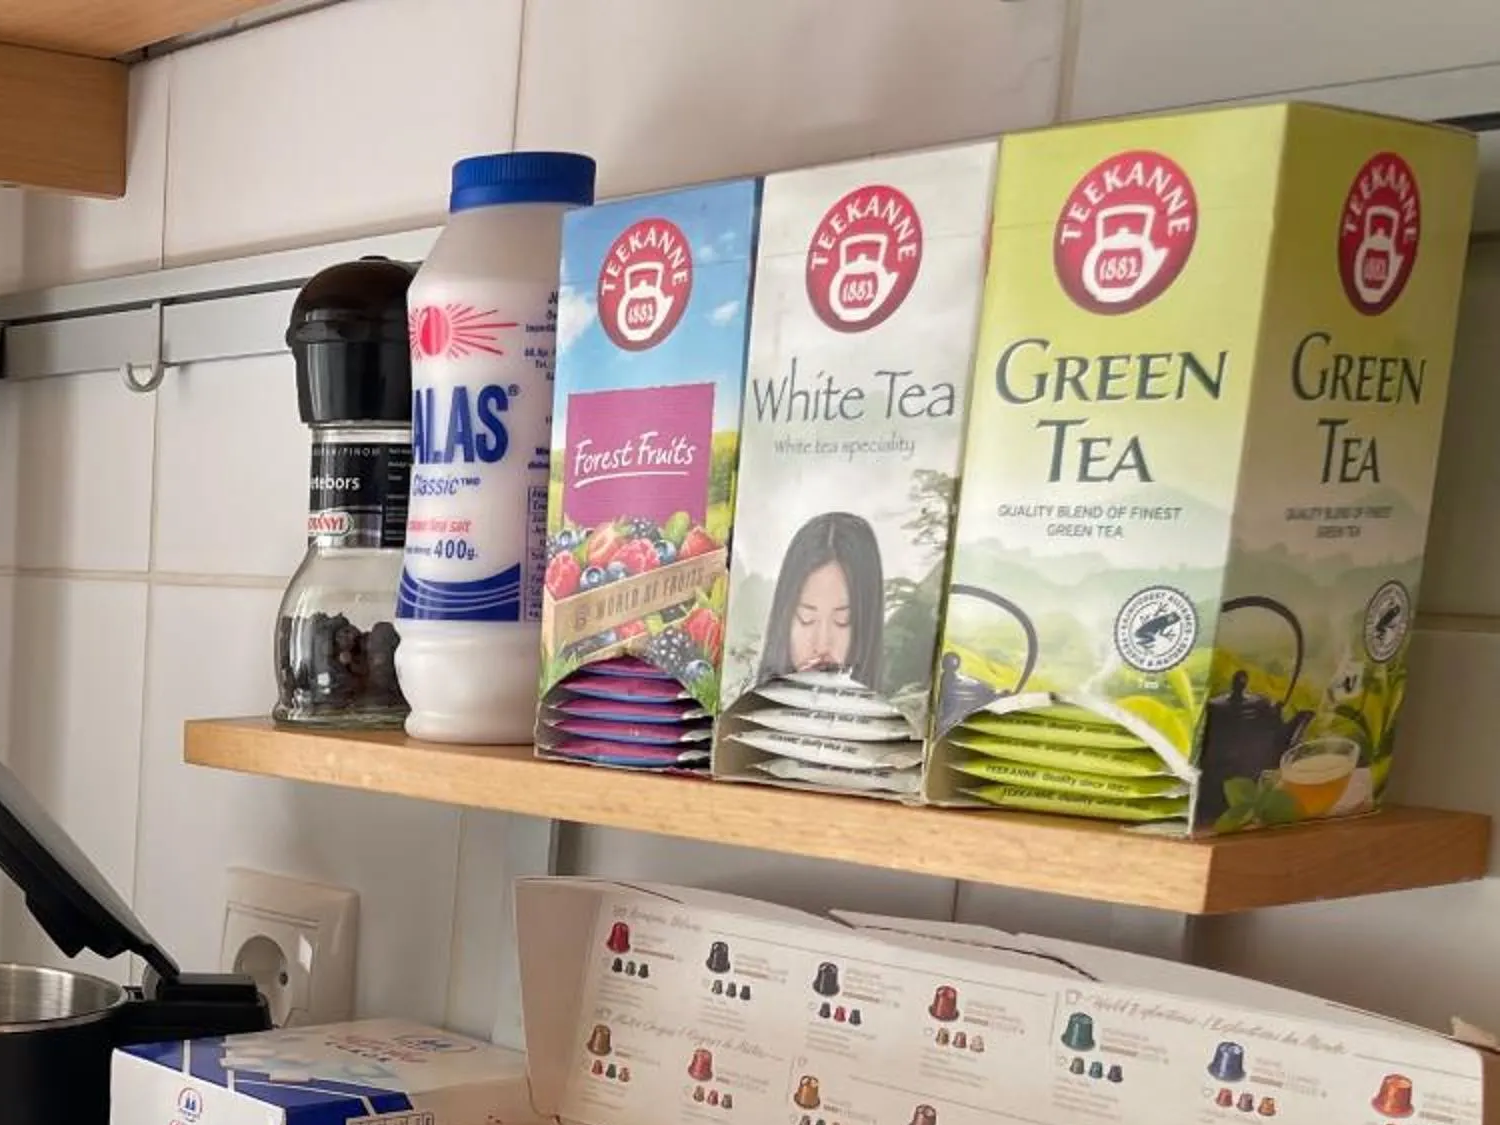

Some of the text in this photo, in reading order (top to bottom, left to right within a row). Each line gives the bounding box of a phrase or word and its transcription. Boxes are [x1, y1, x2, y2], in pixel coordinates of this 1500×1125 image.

[812, 190, 918, 271] TEEKANNE
[1061, 161, 1191, 244] TEEKANNE
[601, 229, 689, 295] TEEKANNE
[753, 356, 956, 424] White Tea
[995, 338, 1228, 405] GREEN
[1291, 332, 1427, 405] GREEN
[574, 430, 695, 477] Forest Fruits
[1036, 417, 1154, 483] TEA
[1317, 418, 1380, 484] TEA
[998, 503, 1184, 521] QUALITY BLEND OF FINEST
[1045, 522, 1125, 539] GREEN TEA
